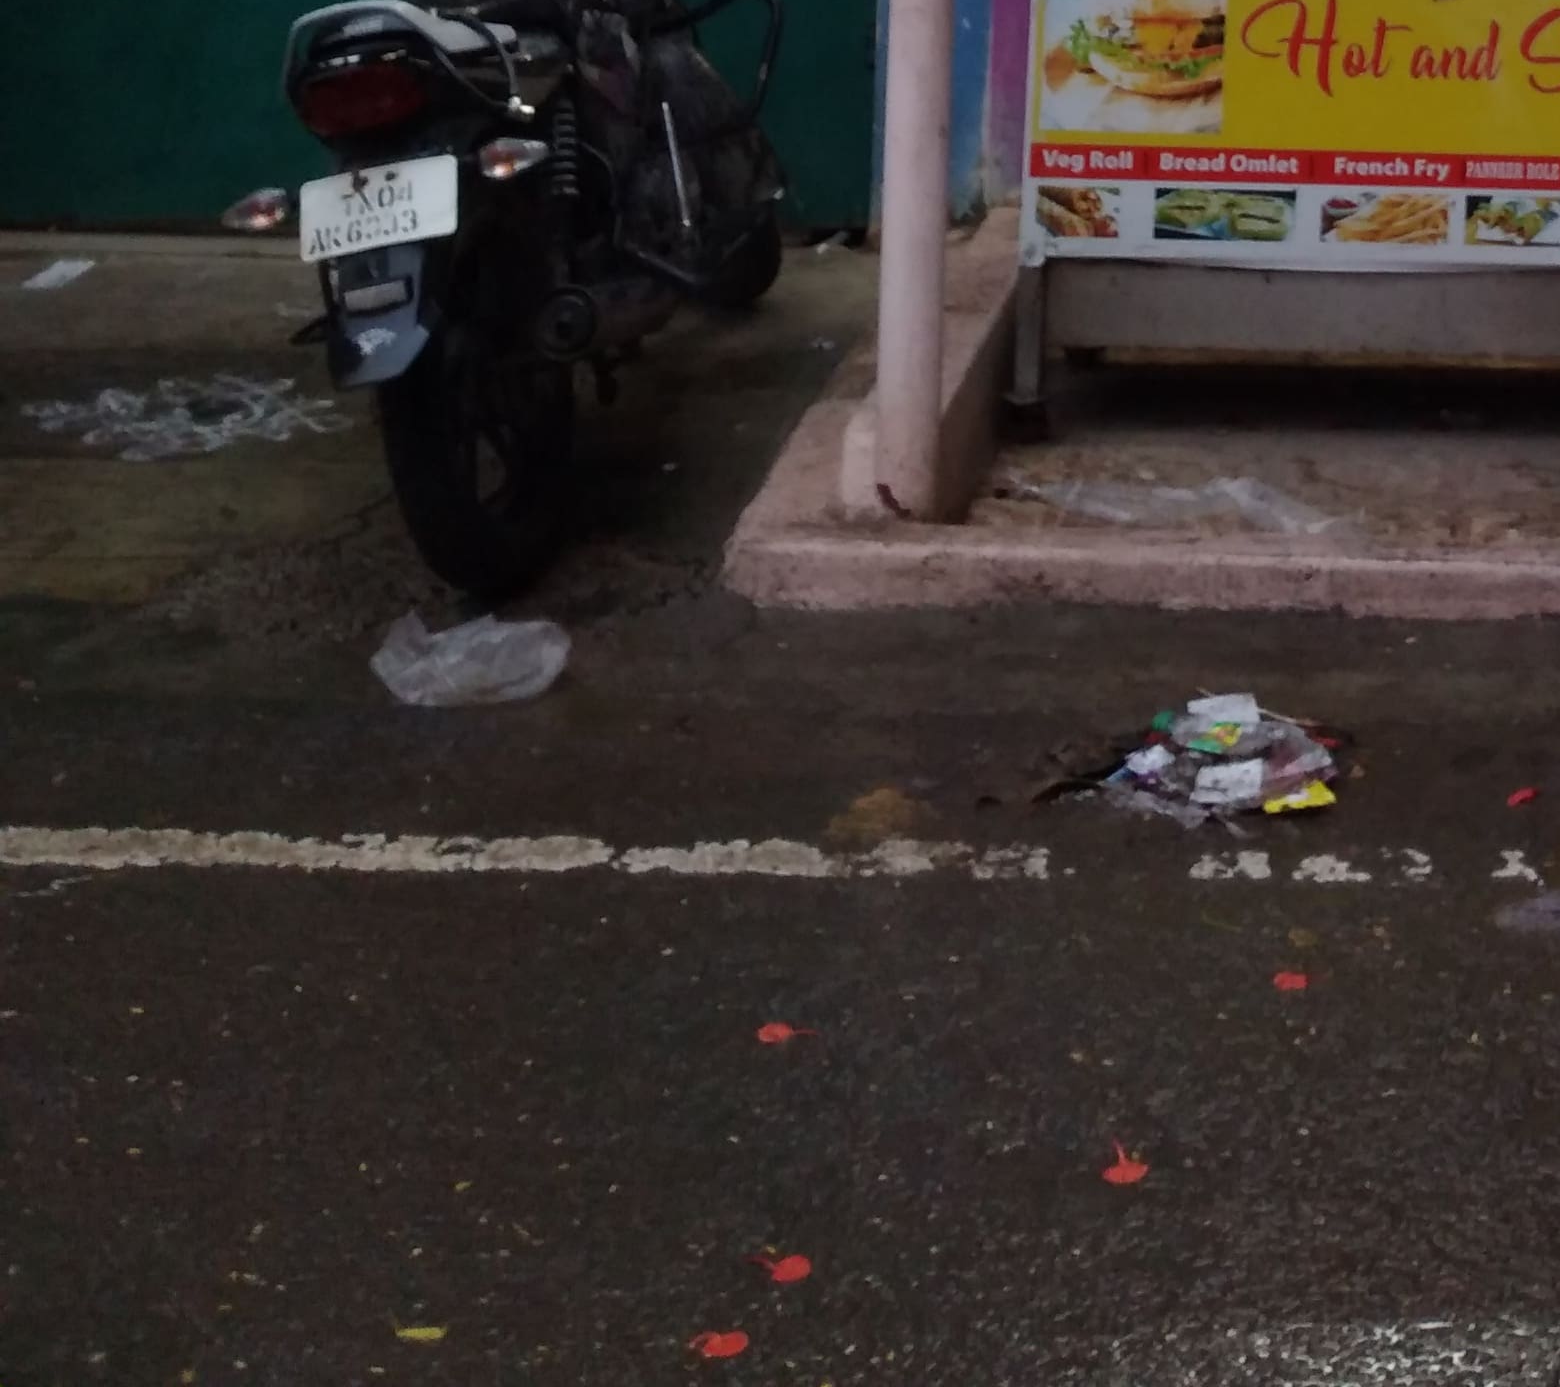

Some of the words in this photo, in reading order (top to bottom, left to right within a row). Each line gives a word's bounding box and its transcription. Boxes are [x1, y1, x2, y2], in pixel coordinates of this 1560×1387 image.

[1411, 21, 1502, 82] and
[1042, 149, 1084, 173] Veg
[1089, 150, 1134, 170] Roll
[1158, 152, 1226, 172] Bread
[1230, 154, 1299, 174] Omlet
[1333, 156, 1409, 176] French
[1414, 158, 1451, 182] Fry
